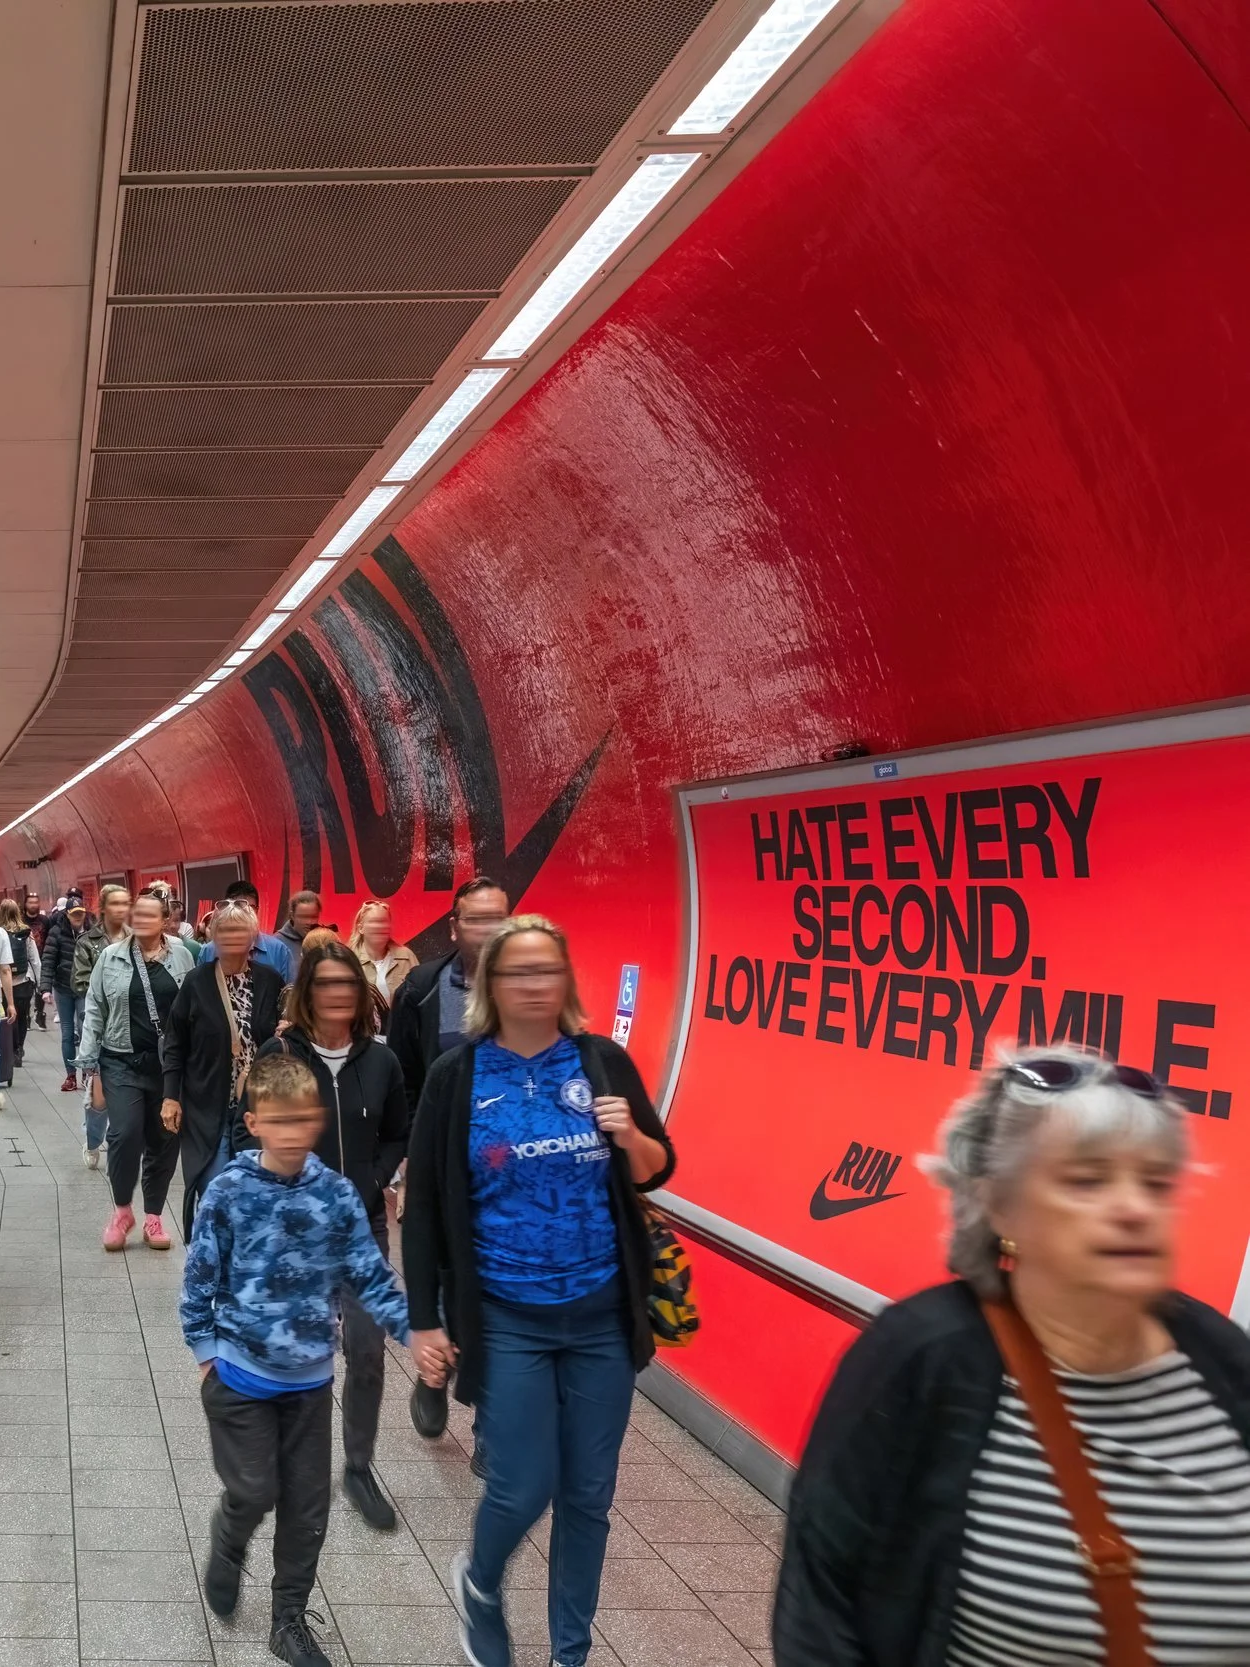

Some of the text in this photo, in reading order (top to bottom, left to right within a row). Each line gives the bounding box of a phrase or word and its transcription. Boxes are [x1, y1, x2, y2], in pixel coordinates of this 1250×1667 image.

[750, 777, 1103, 881] HATE EVERY
[793, 884, 1047, 981] SECOND.
[704, 954, 808, 1037] LOVE
[815, 967, 1010, 1072] EVERY
[510, 1131, 605, 1160] YOKOHAM
[573, 1147, 611, 1164] TYRES
[833, 1141, 902, 1198] RUN
